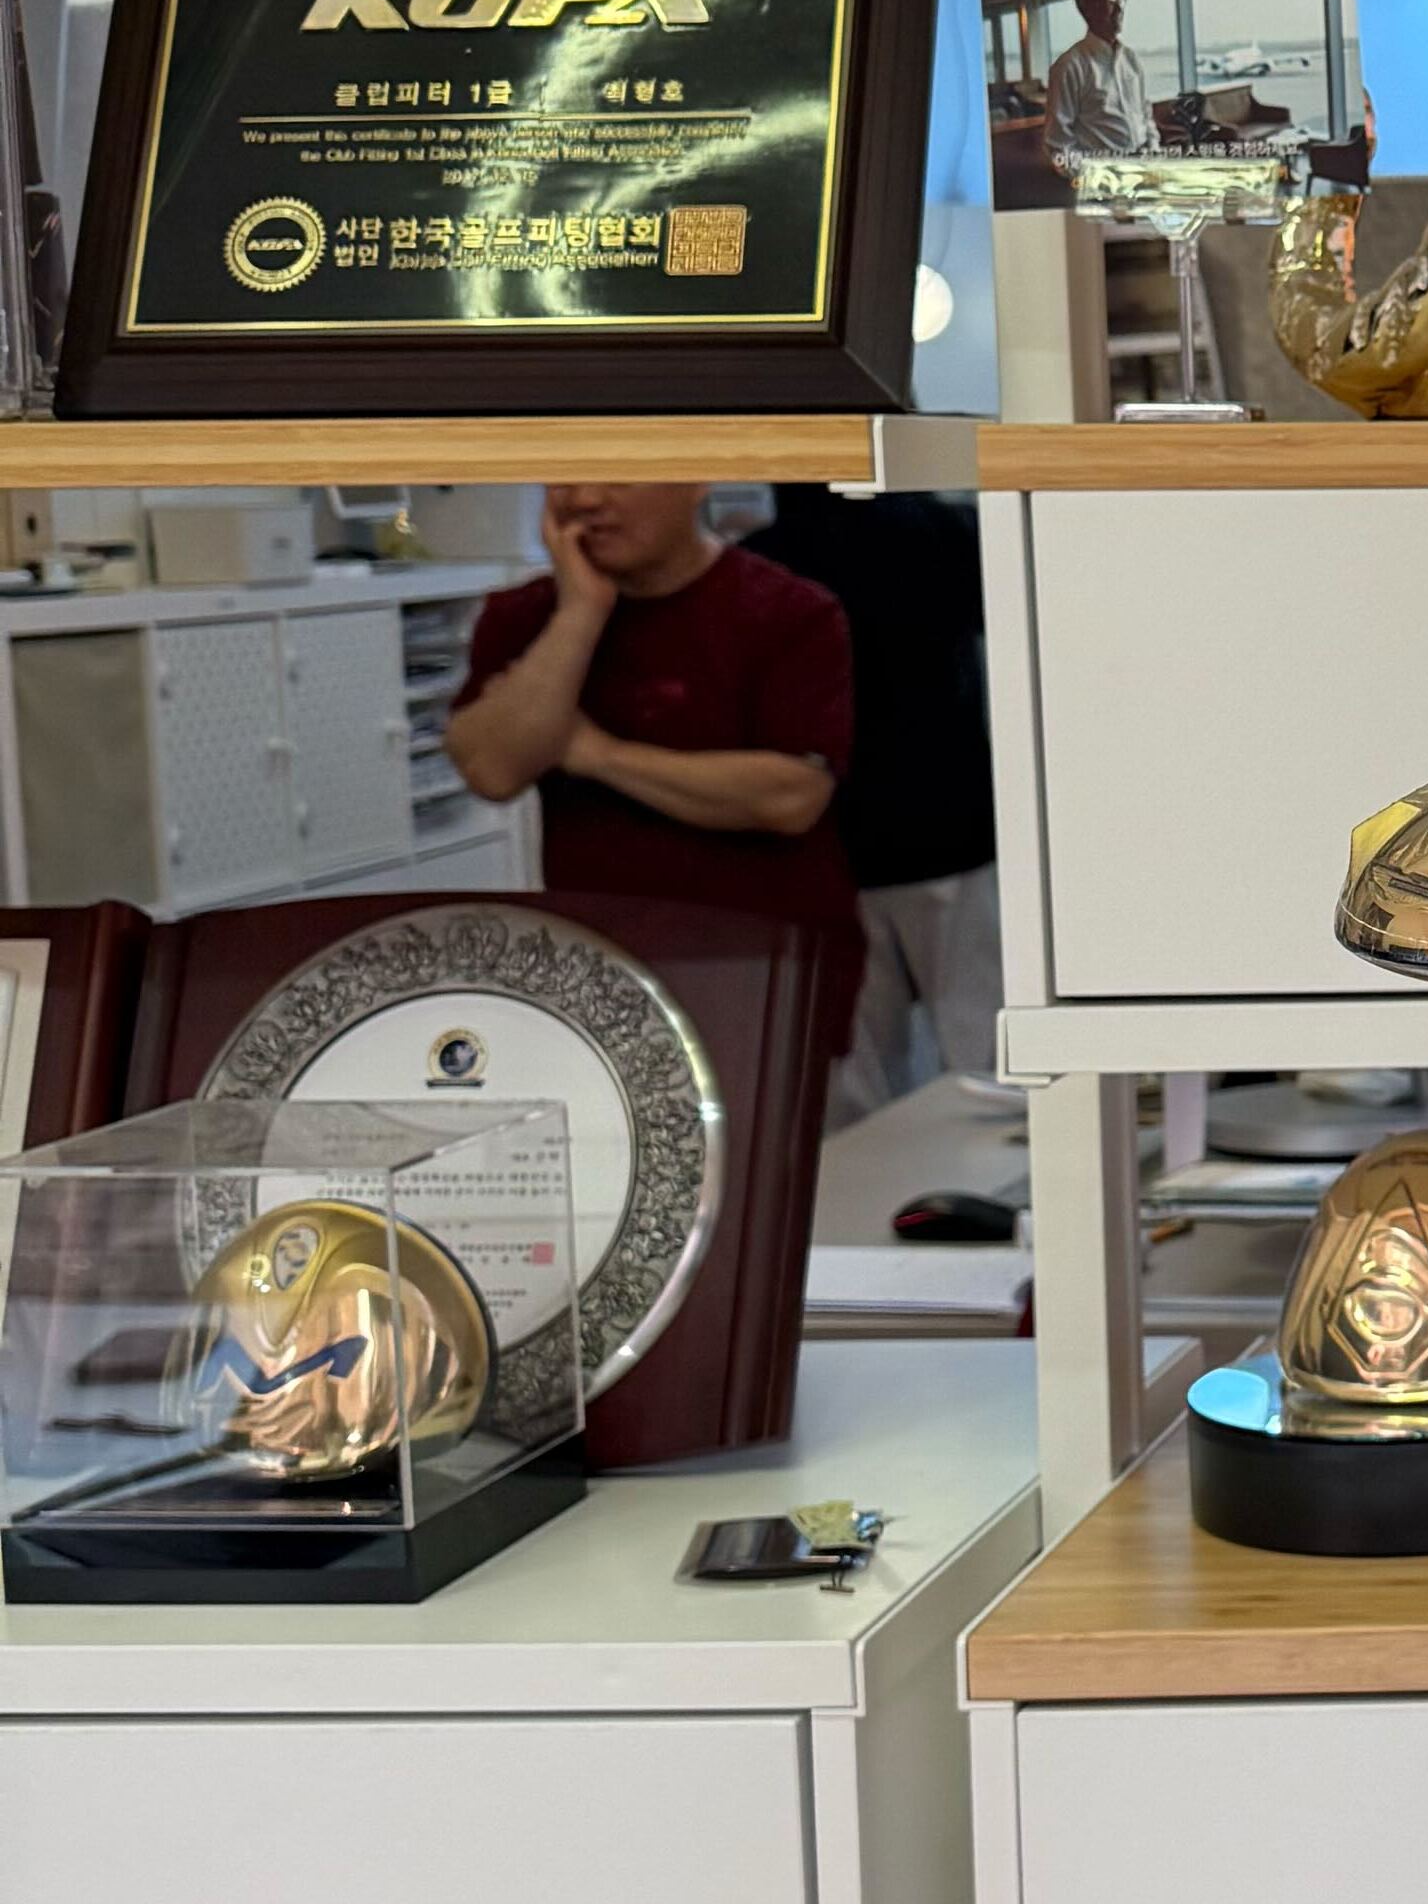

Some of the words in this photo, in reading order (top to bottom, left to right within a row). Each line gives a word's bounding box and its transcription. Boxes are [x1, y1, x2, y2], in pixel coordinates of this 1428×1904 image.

[335, 216, 383, 240] 사단
[389, 214, 662, 250] 한국골프피팅협회
[334, 242, 379, 268] 법인
